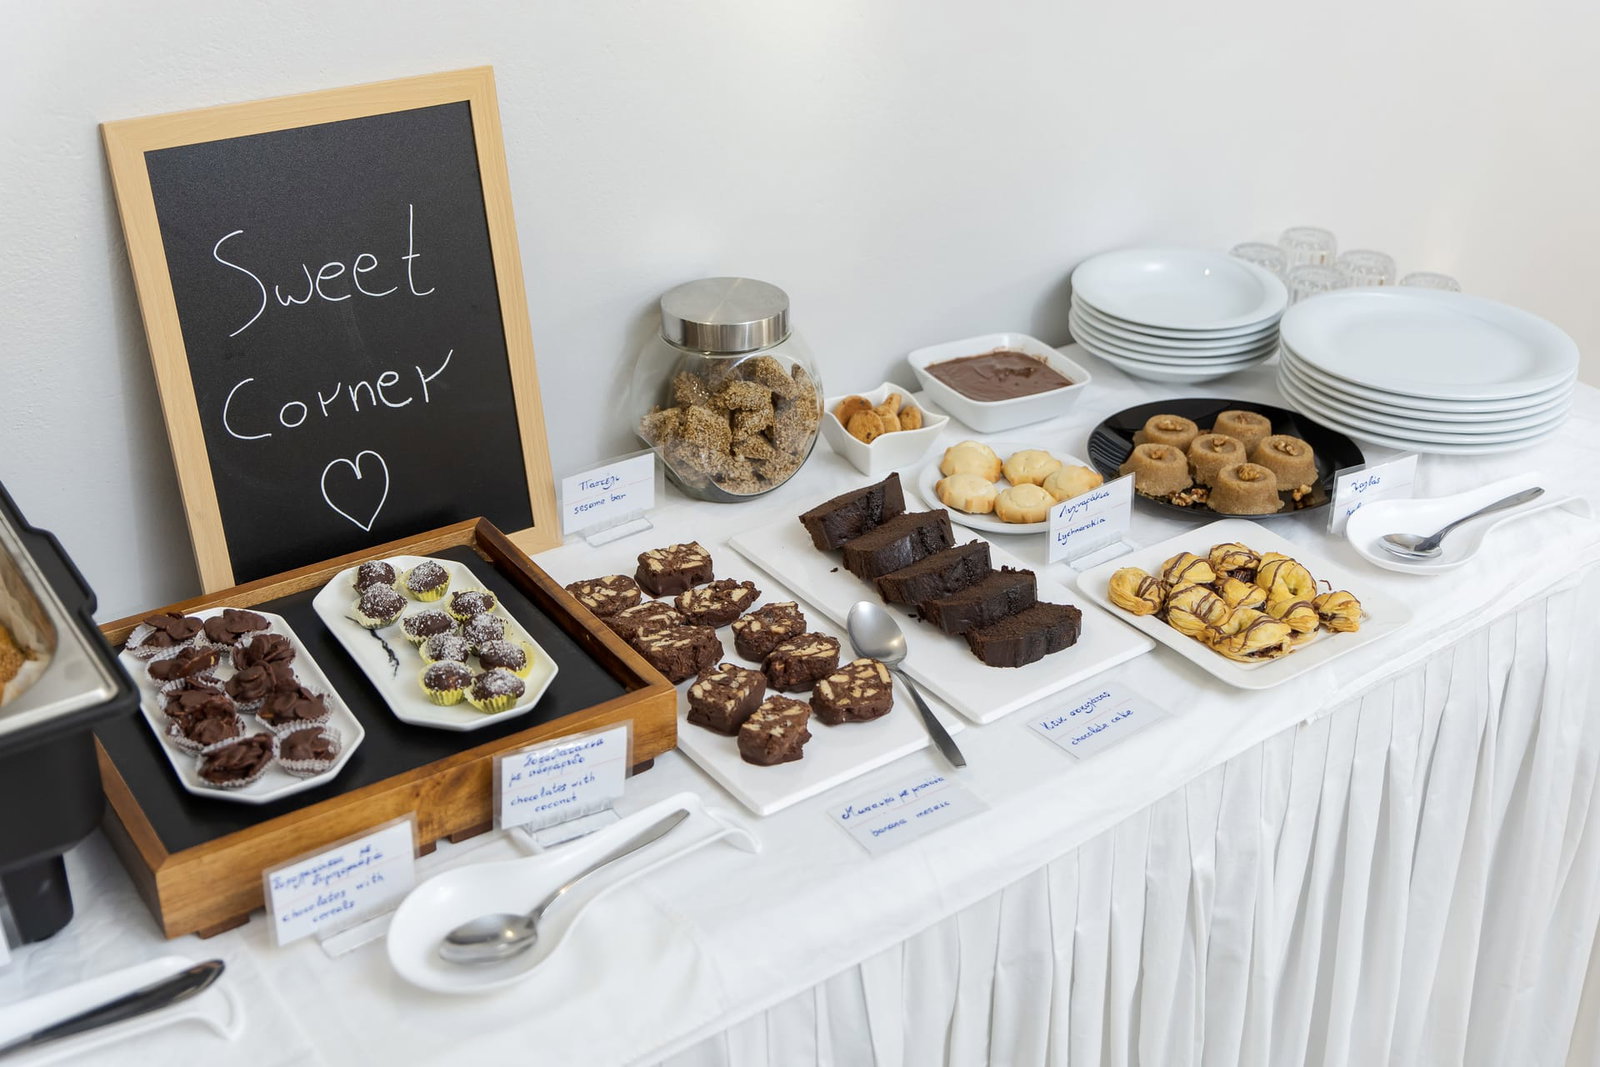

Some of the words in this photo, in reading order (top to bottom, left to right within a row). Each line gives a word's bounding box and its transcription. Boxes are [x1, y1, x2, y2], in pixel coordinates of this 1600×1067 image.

[213, 203, 436, 338] Sweet
[223, 348, 454, 440] Corner
[574, 499, 605, 515] sesame
[610, 493, 626, 502] bar
